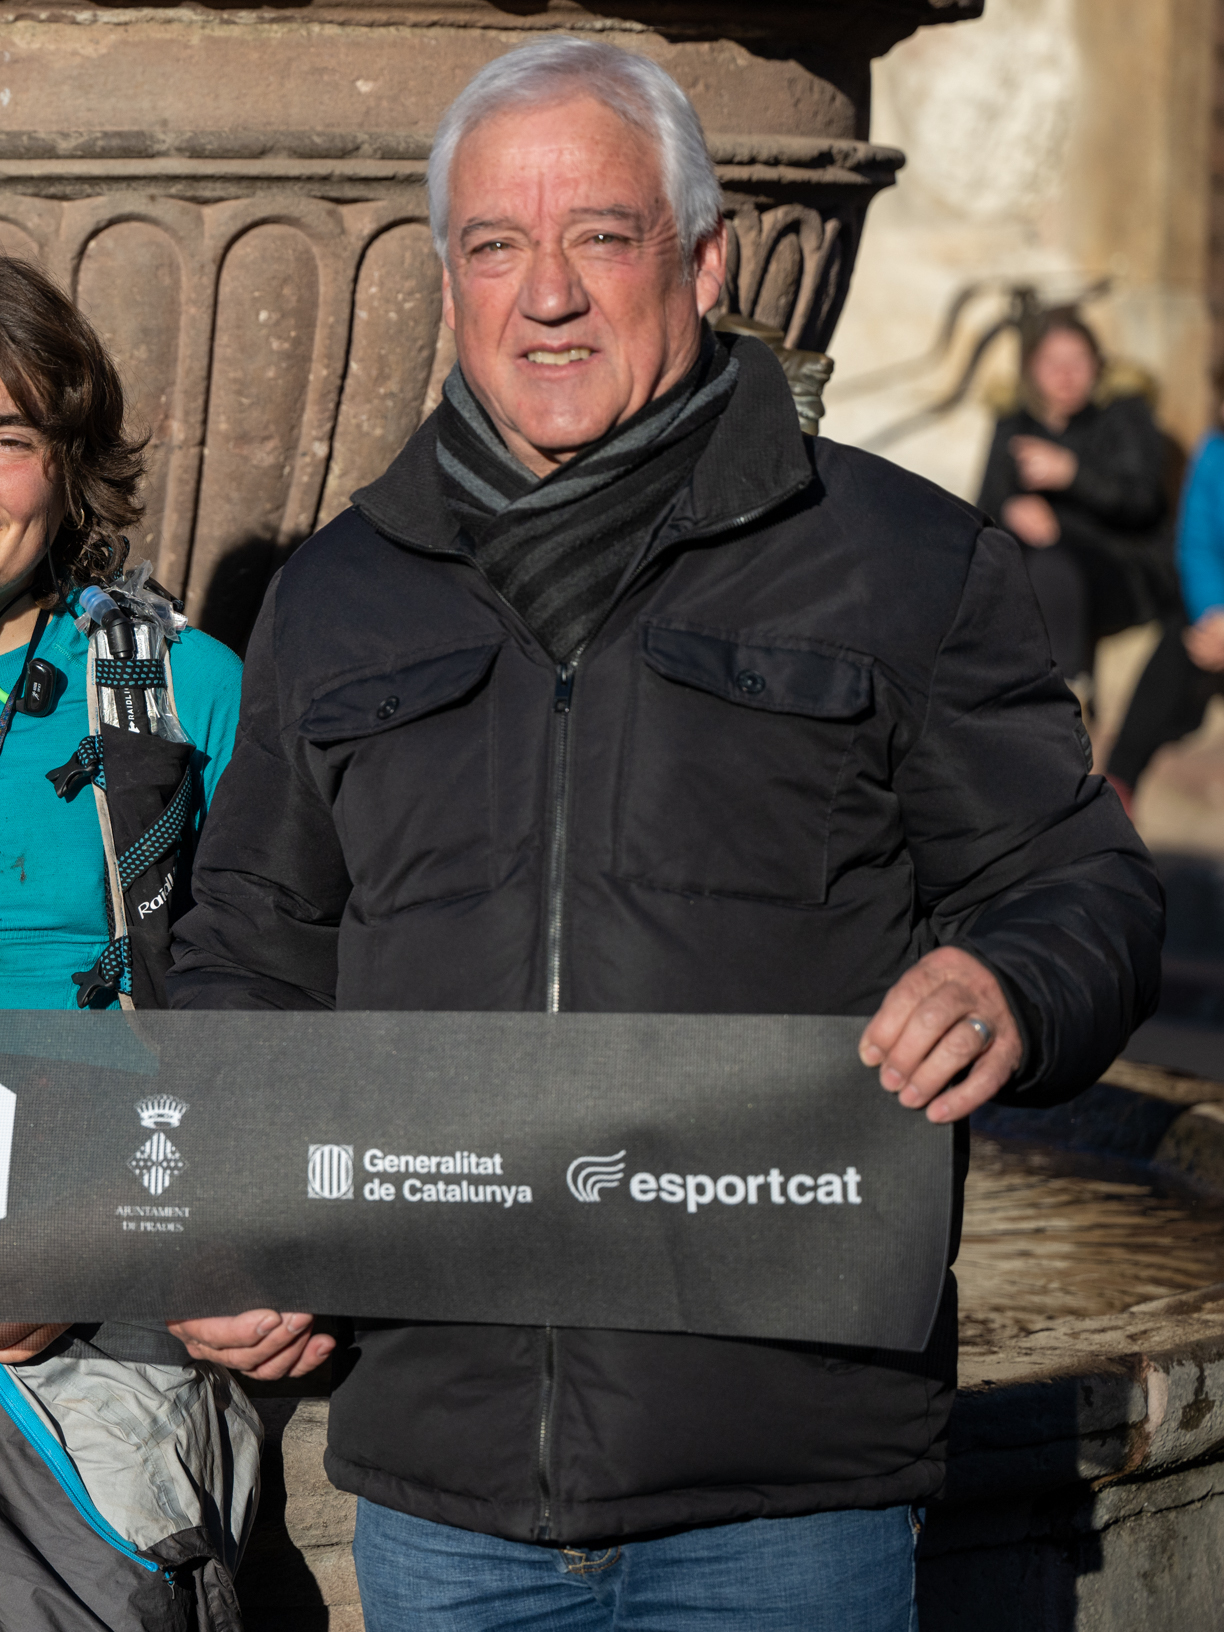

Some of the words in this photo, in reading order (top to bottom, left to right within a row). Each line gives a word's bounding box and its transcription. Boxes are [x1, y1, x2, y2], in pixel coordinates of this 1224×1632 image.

[123, 687, 135, 720] RAIDLI
[137, 872, 174, 919] Raidl
[363, 1148, 504, 1175] Generalitat
[363, 1178, 396, 1201] de
[402, 1178, 534, 1208] Catalunya
[629, 1166, 862, 1213] esportcat
